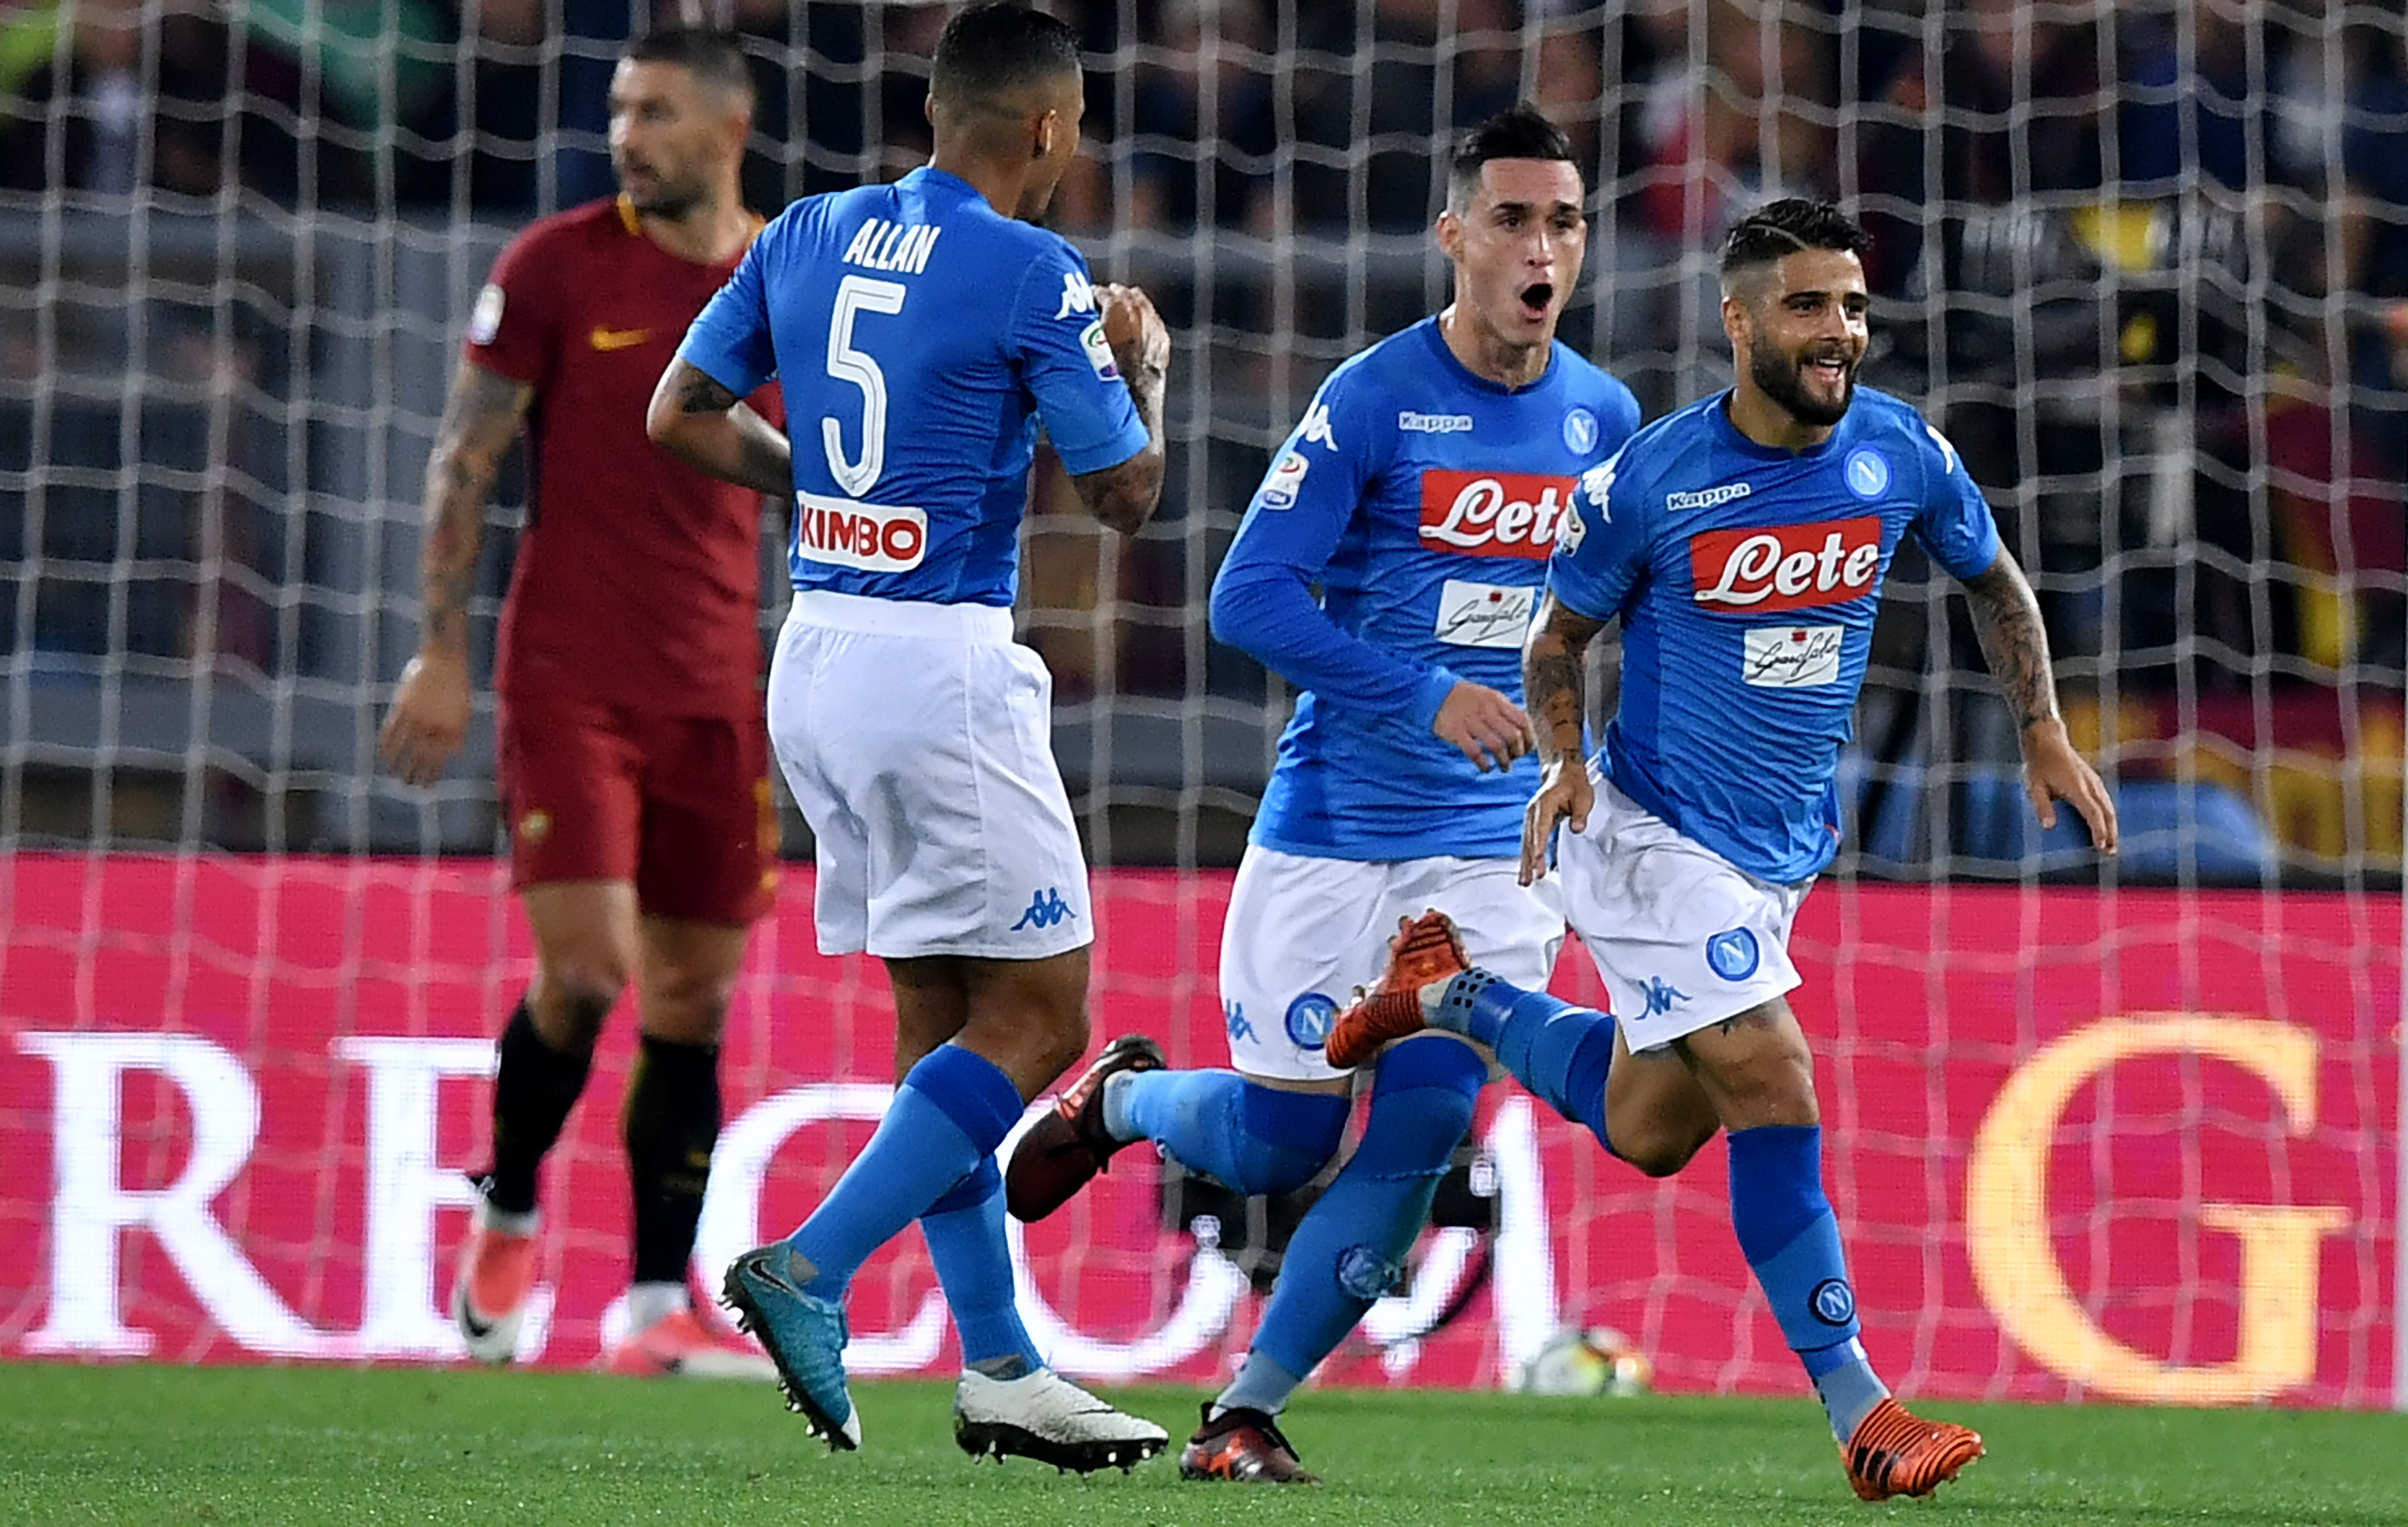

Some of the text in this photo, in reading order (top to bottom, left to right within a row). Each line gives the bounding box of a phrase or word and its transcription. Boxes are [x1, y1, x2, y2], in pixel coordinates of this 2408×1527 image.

[841, 217, 941, 274] ALLAN
[822, 274, 906, 497] 5
[1399, 411, 1472, 433] Kappa
[1857, 459, 1878, 486] N
[1418, 479, 1570, 548] Let
[1666, 483, 1751, 510] Kappa
[801, 503, 922, 561] KIMBO
[1693, 532, 1878, 605] Lete
[1719, 937, 1746, 968] N
[1300, 1008, 1326, 1035] N
[1964, 1011, 2350, 1407] G
[1824, 1288, 1847, 1314] N
